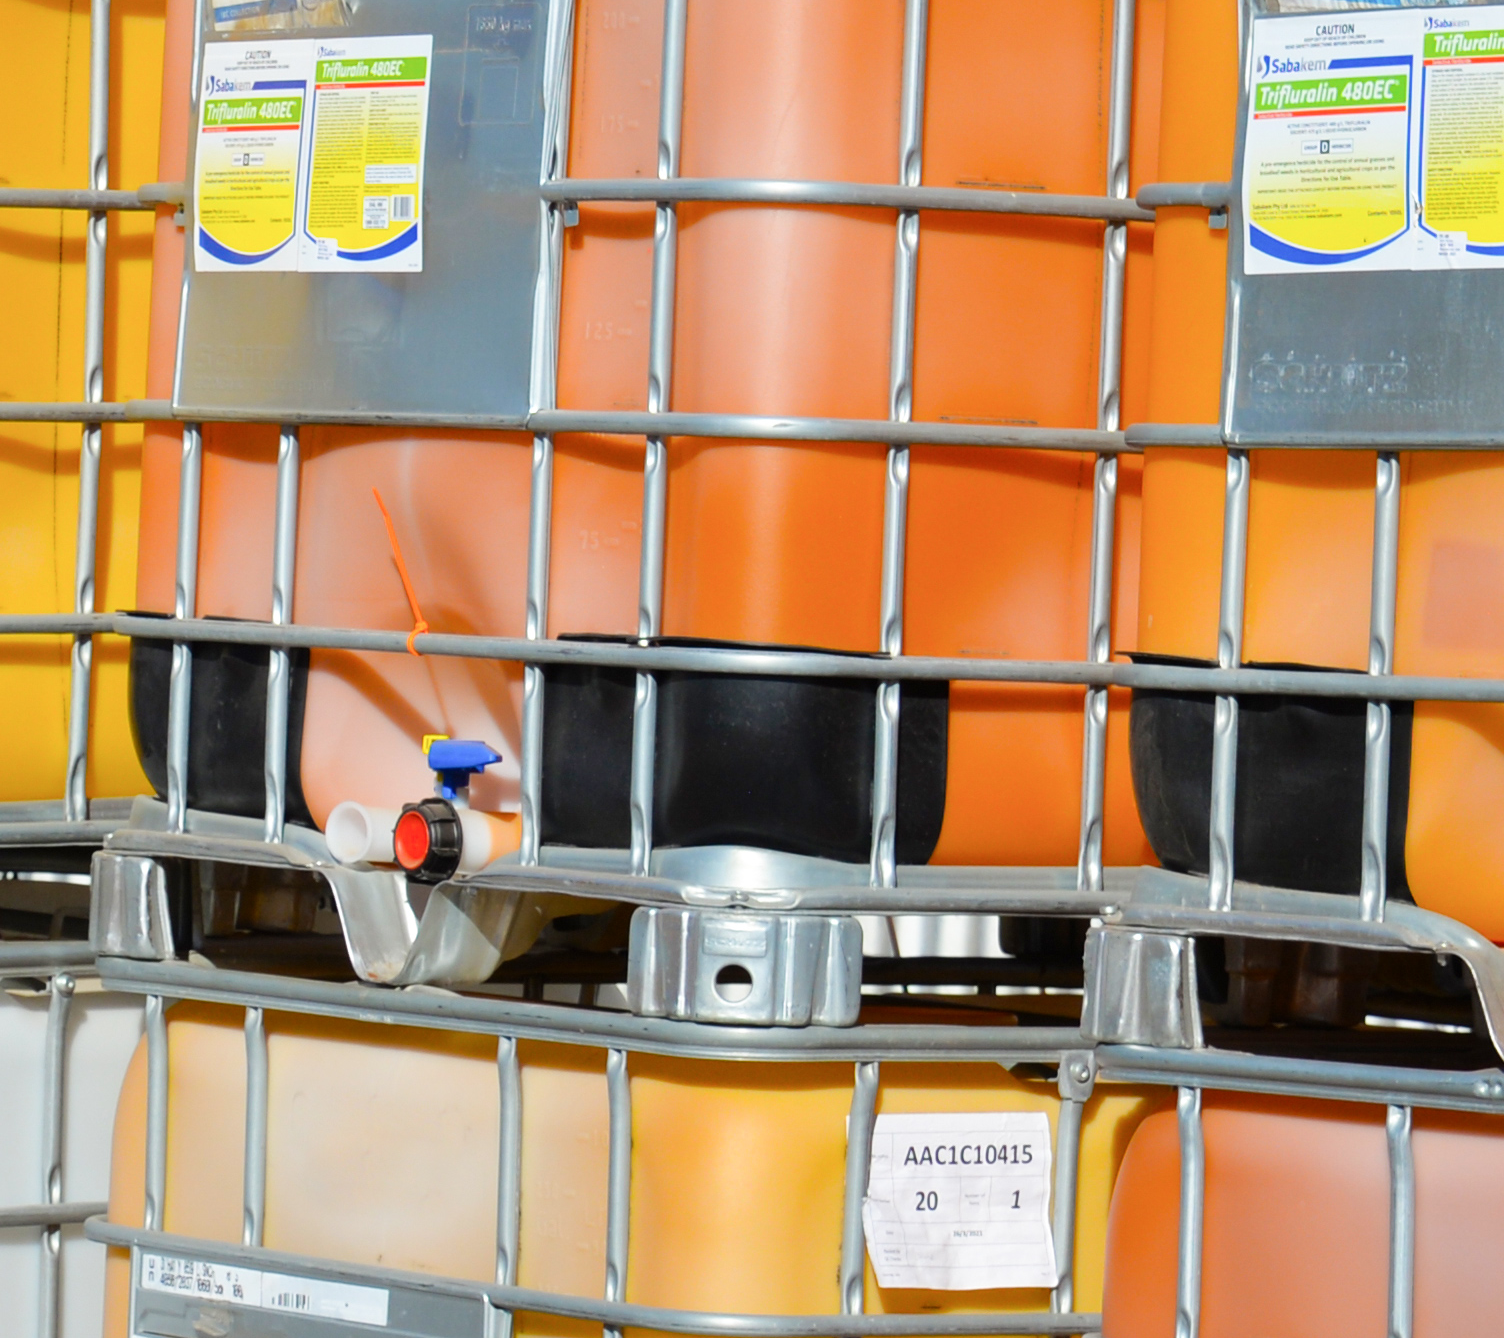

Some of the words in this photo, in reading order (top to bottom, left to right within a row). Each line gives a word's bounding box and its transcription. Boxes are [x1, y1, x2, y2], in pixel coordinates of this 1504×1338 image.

[1316, 24, 1355, 36] CAUTION
[1434, 18, 1469, 28] Sabakem
[245, 50, 271, 60] CAUTION
[322, 61, 369, 81] Trifluralin
[1272, 57, 1326, 73] Sabakem
[216, 78, 251, 92] Sabakem
[1260, 81, 1337, 109] Trifluralin
[207, 101, 257, 124] Trifluralin
[904, 1145, 1033, 1165] AAC1C10415
[915, 1191, 938, 1211] 20
[1011, 1190, 1021, 1209] 1
